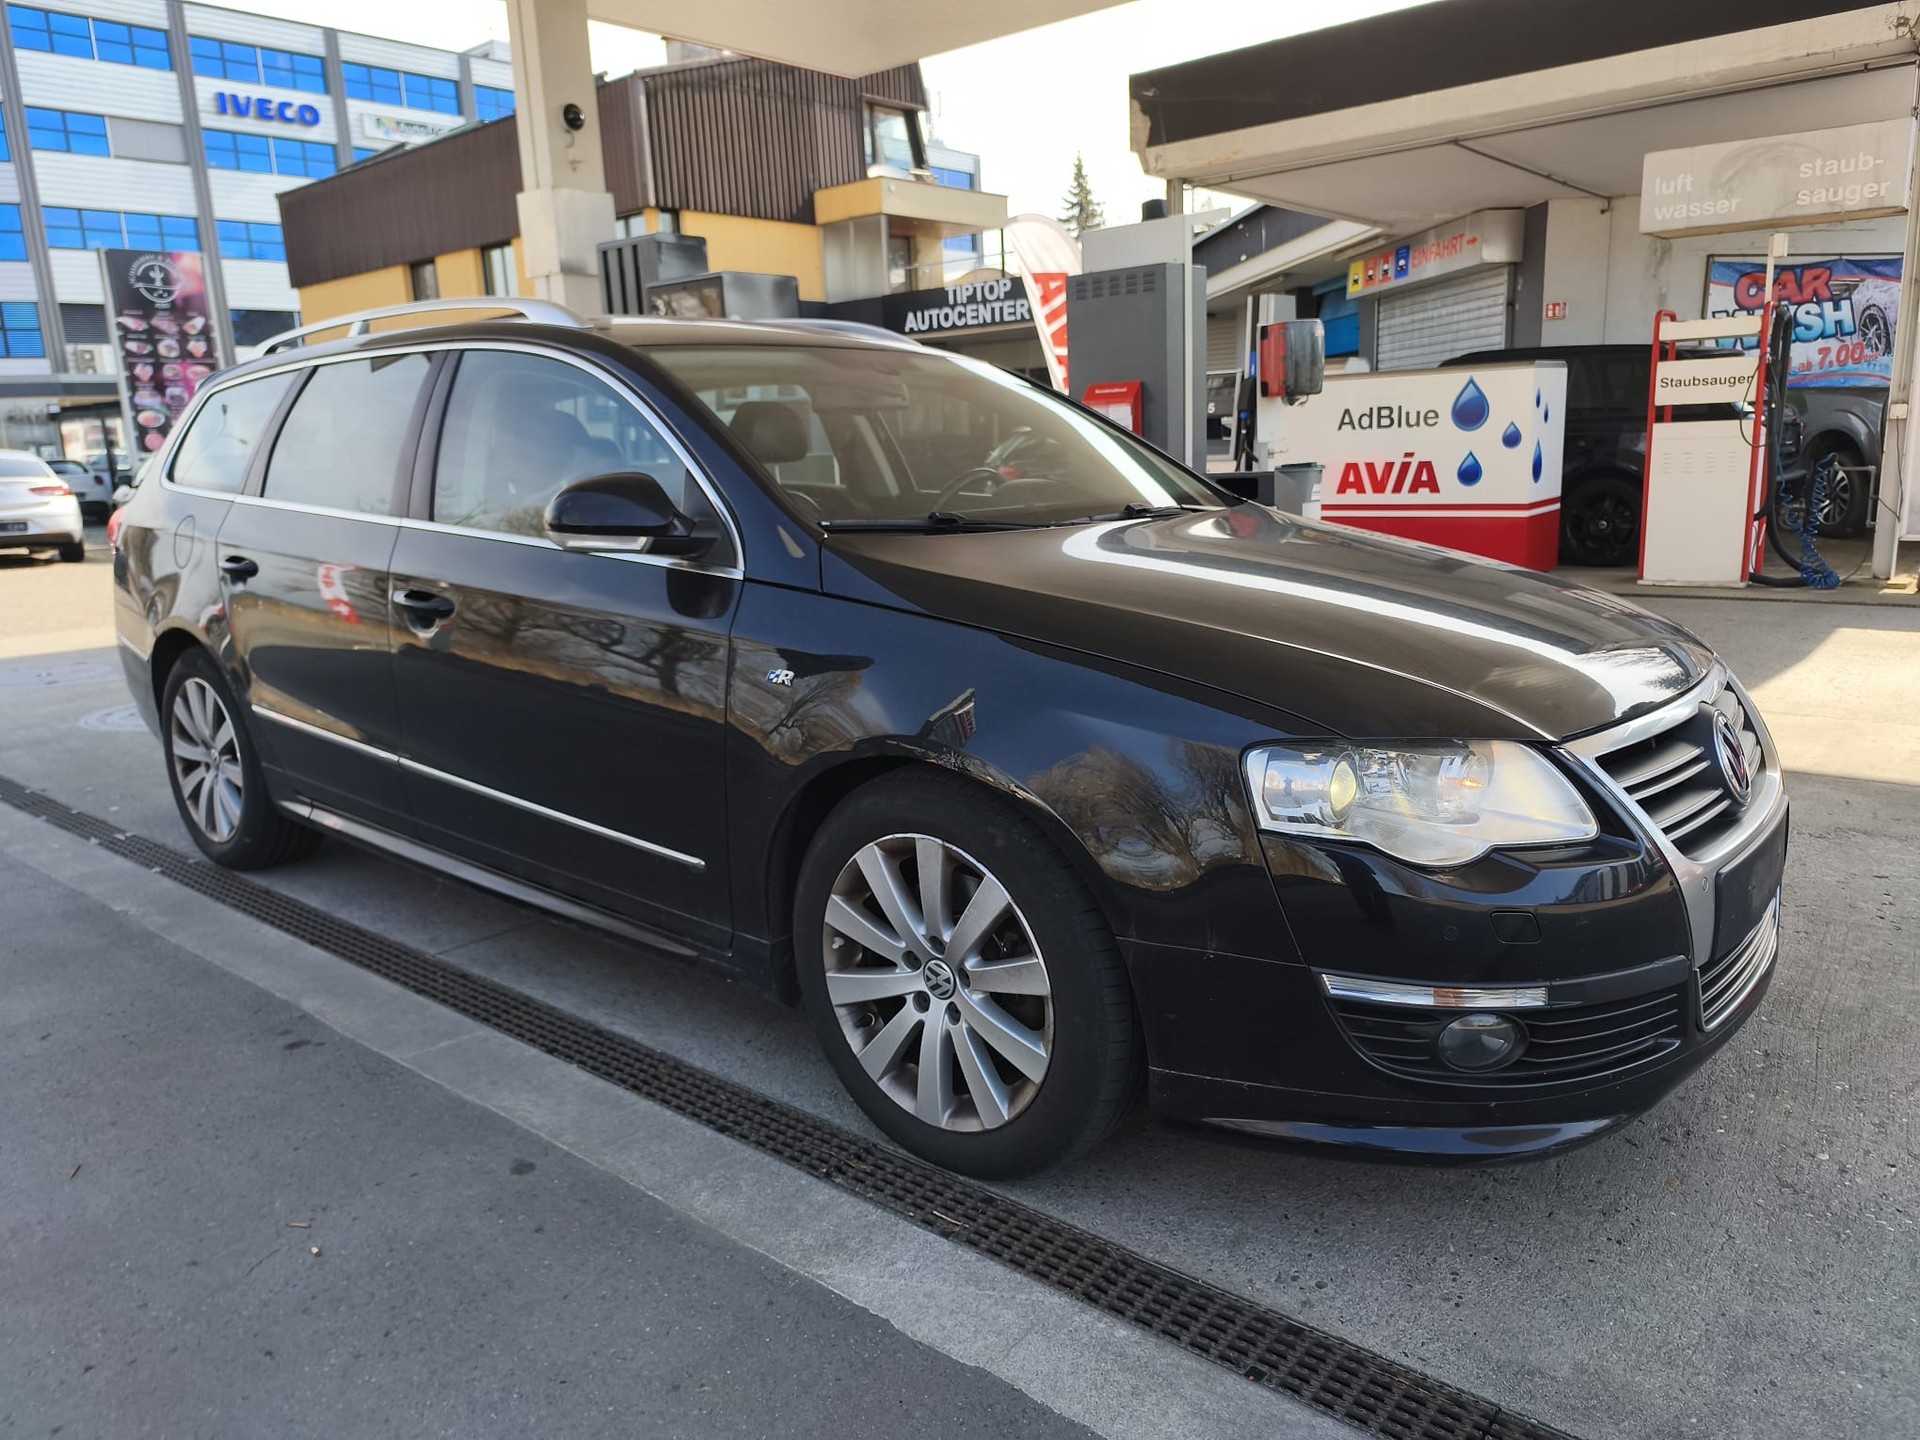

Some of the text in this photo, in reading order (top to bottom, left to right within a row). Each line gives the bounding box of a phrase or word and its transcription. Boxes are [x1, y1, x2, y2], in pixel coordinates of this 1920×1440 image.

[216, 91, 321, 127] IVECO
[1799, 151, 1884, 178] staub-
[1654, 174, 1694, 196] luft
[1796, 180, 1892, 205] sauger
[1653, 197, 1742, 221] wasser
[1410, 233, 1466, 269] EINFAHRT
[945, 279, 1012, 305] TIPTOP
[1734, 266, 1833, 310] CAR
[904, 298, 1031, 333] AUTOCENTER
[1817, 341, 1866, 370] 7.00
[1660, 375, 1754, 388] Staubsauger
[1337, 405, 1440, 431] AdBlue
